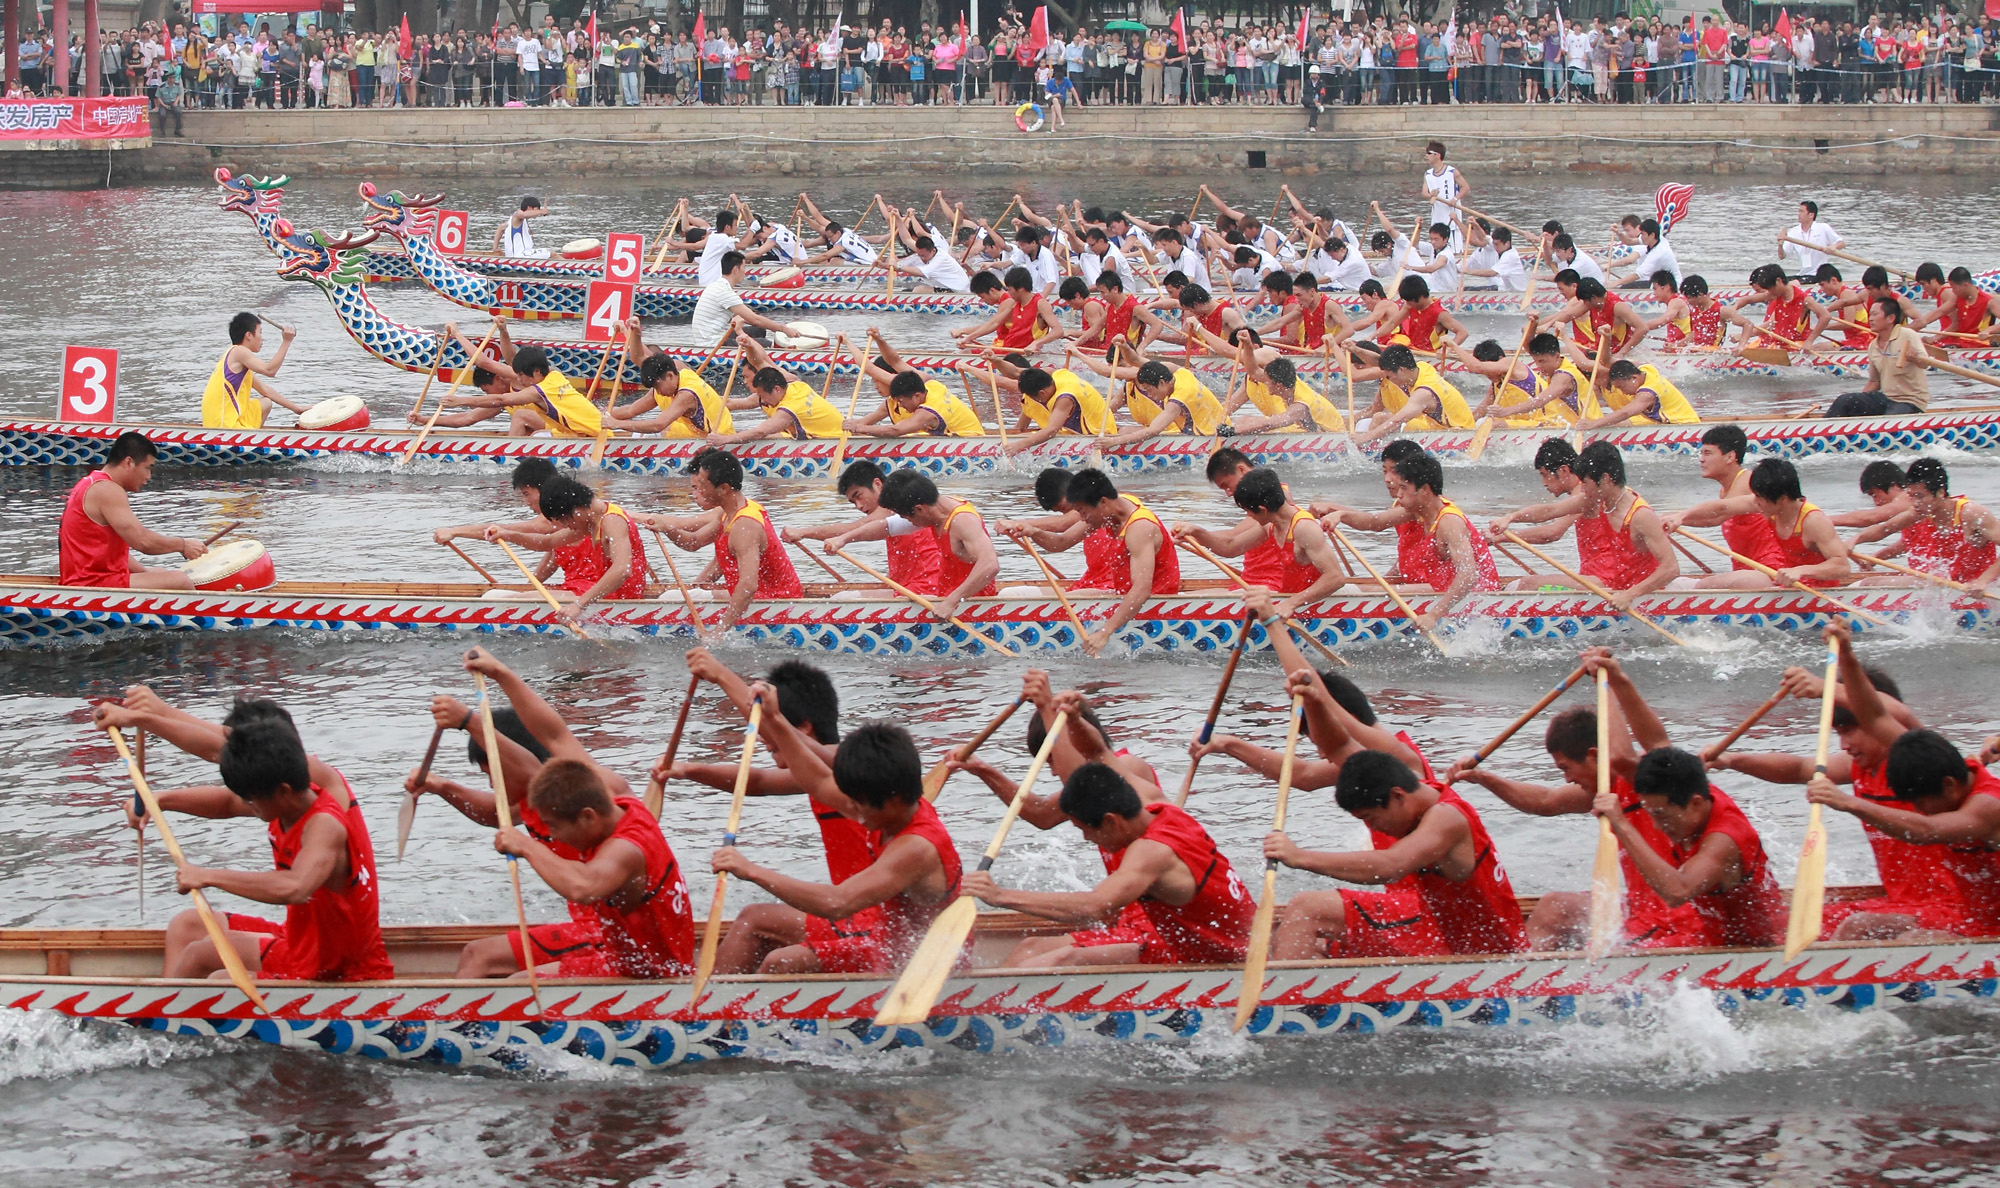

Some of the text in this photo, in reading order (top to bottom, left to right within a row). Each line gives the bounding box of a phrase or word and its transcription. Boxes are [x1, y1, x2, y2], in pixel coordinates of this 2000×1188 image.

[440, 215, 463, 249] 6
[611, 240, 637, 278] 5
[500, 285, 521, 304] 11
[590, 290, 623, 338] 4
[69, 356, 108, 415] 3
